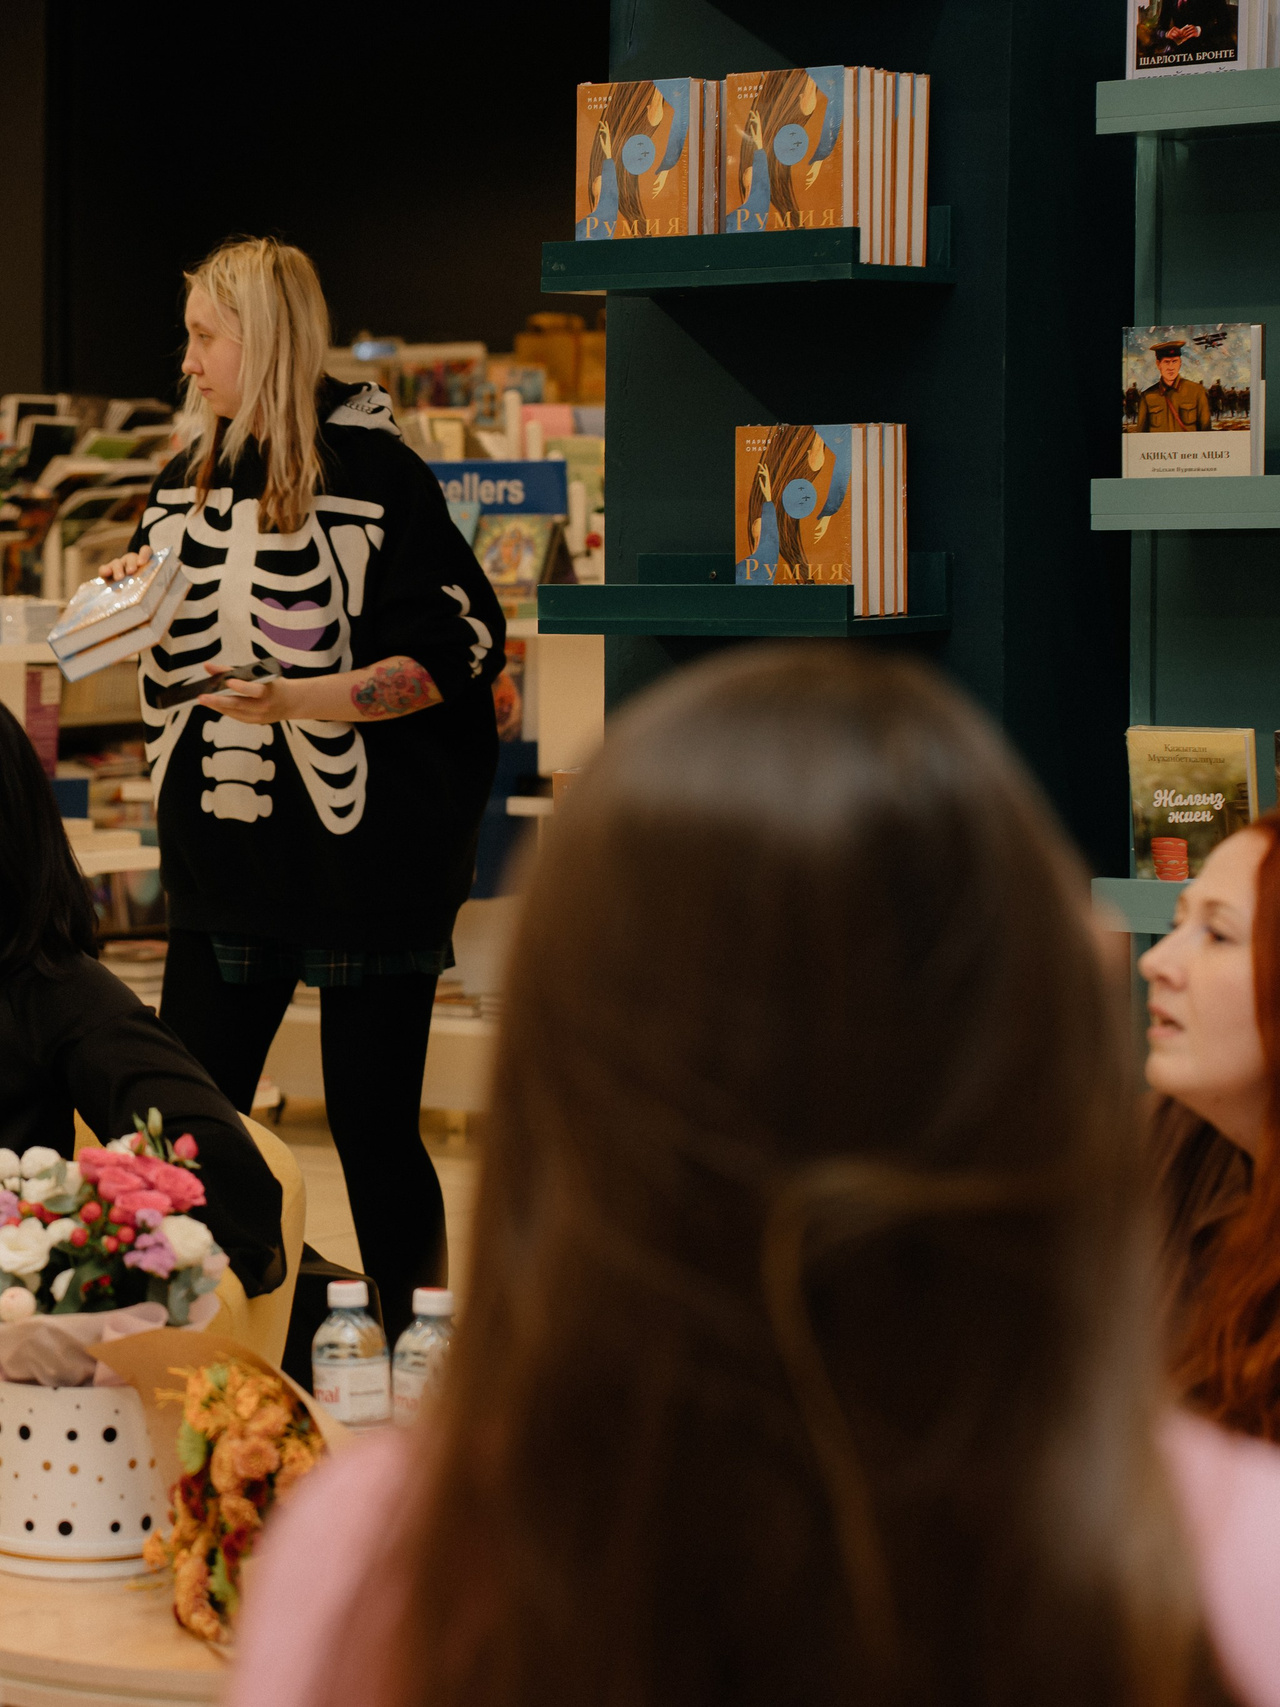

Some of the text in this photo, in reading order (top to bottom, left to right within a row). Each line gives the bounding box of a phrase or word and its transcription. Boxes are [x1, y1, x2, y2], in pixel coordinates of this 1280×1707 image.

[1139, 49, 1235, 65] ШАРЛОТТА БРОНТЕ
[737, 84, 763, 92] МАРИЯ
[1167, 810, 1214, 824] жиен
